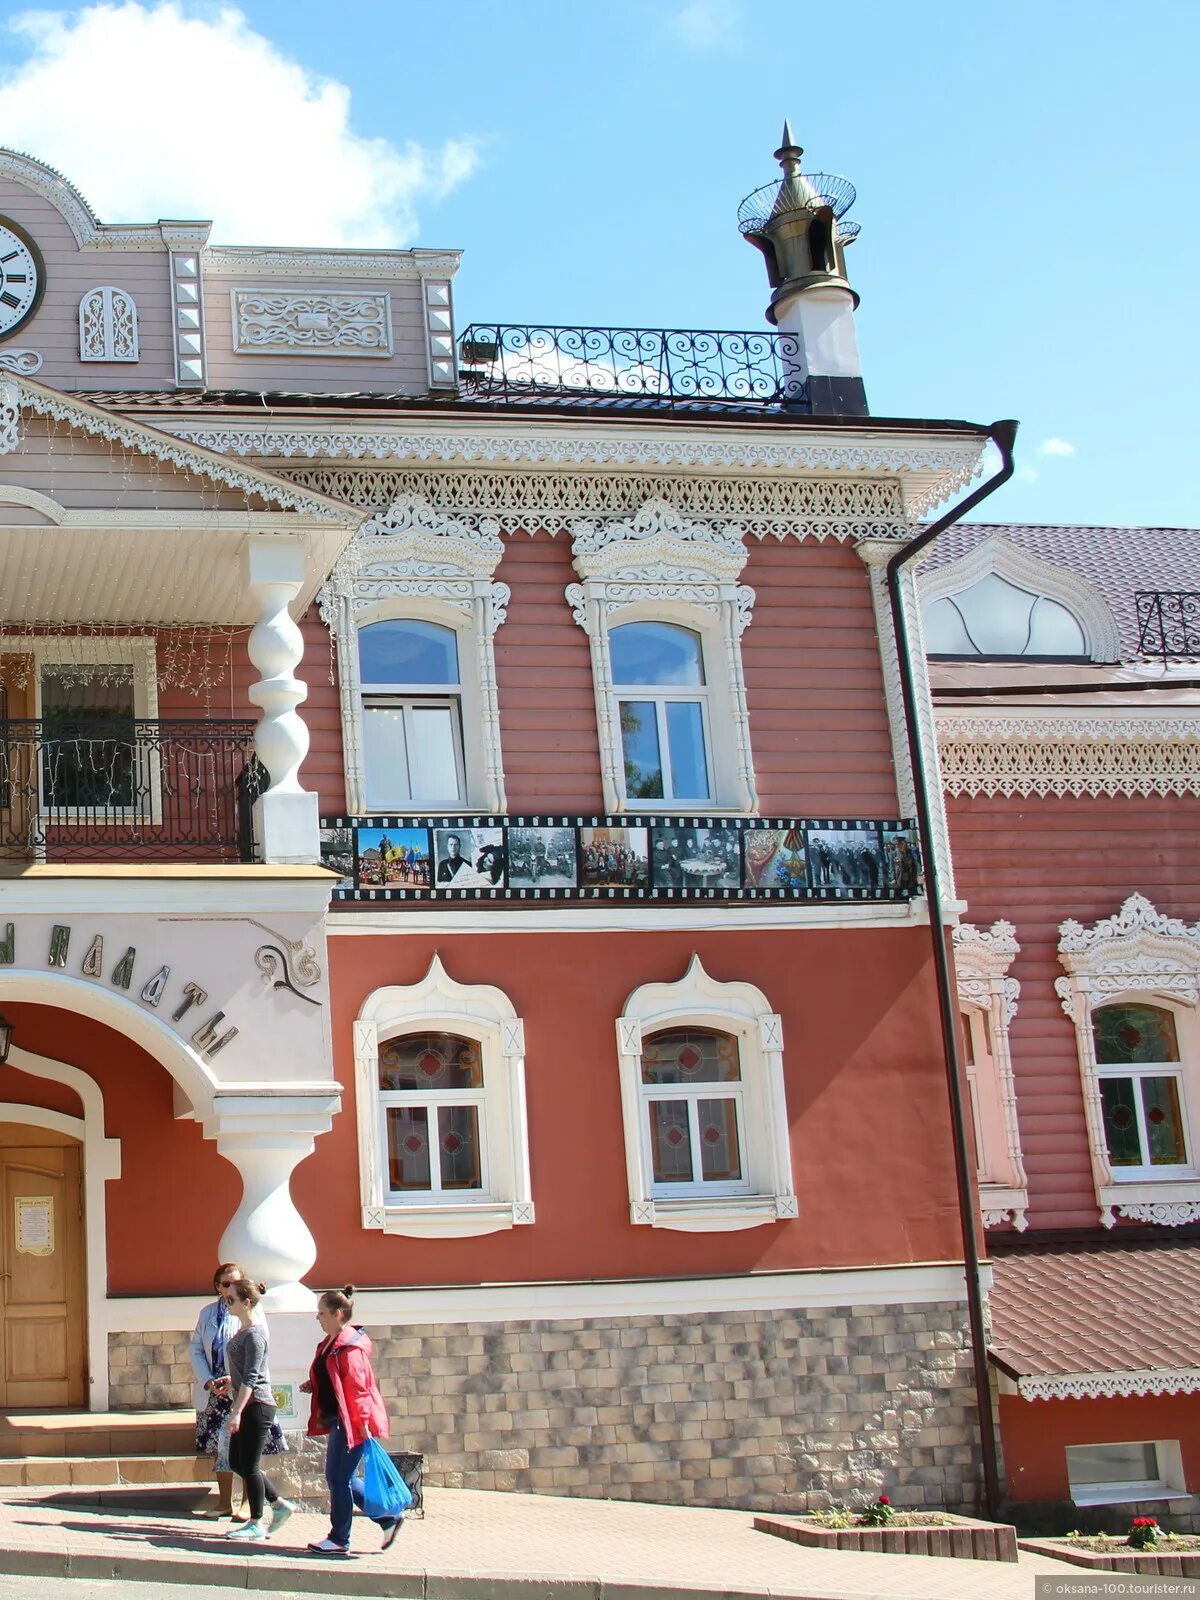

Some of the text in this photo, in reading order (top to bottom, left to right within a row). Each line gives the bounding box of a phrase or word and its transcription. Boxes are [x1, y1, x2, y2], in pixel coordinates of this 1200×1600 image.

[0, 251, 20, 264] II
[6, 274, 27, 284] III
[48, 924, 240, 1058] ПАЛАТЫ
